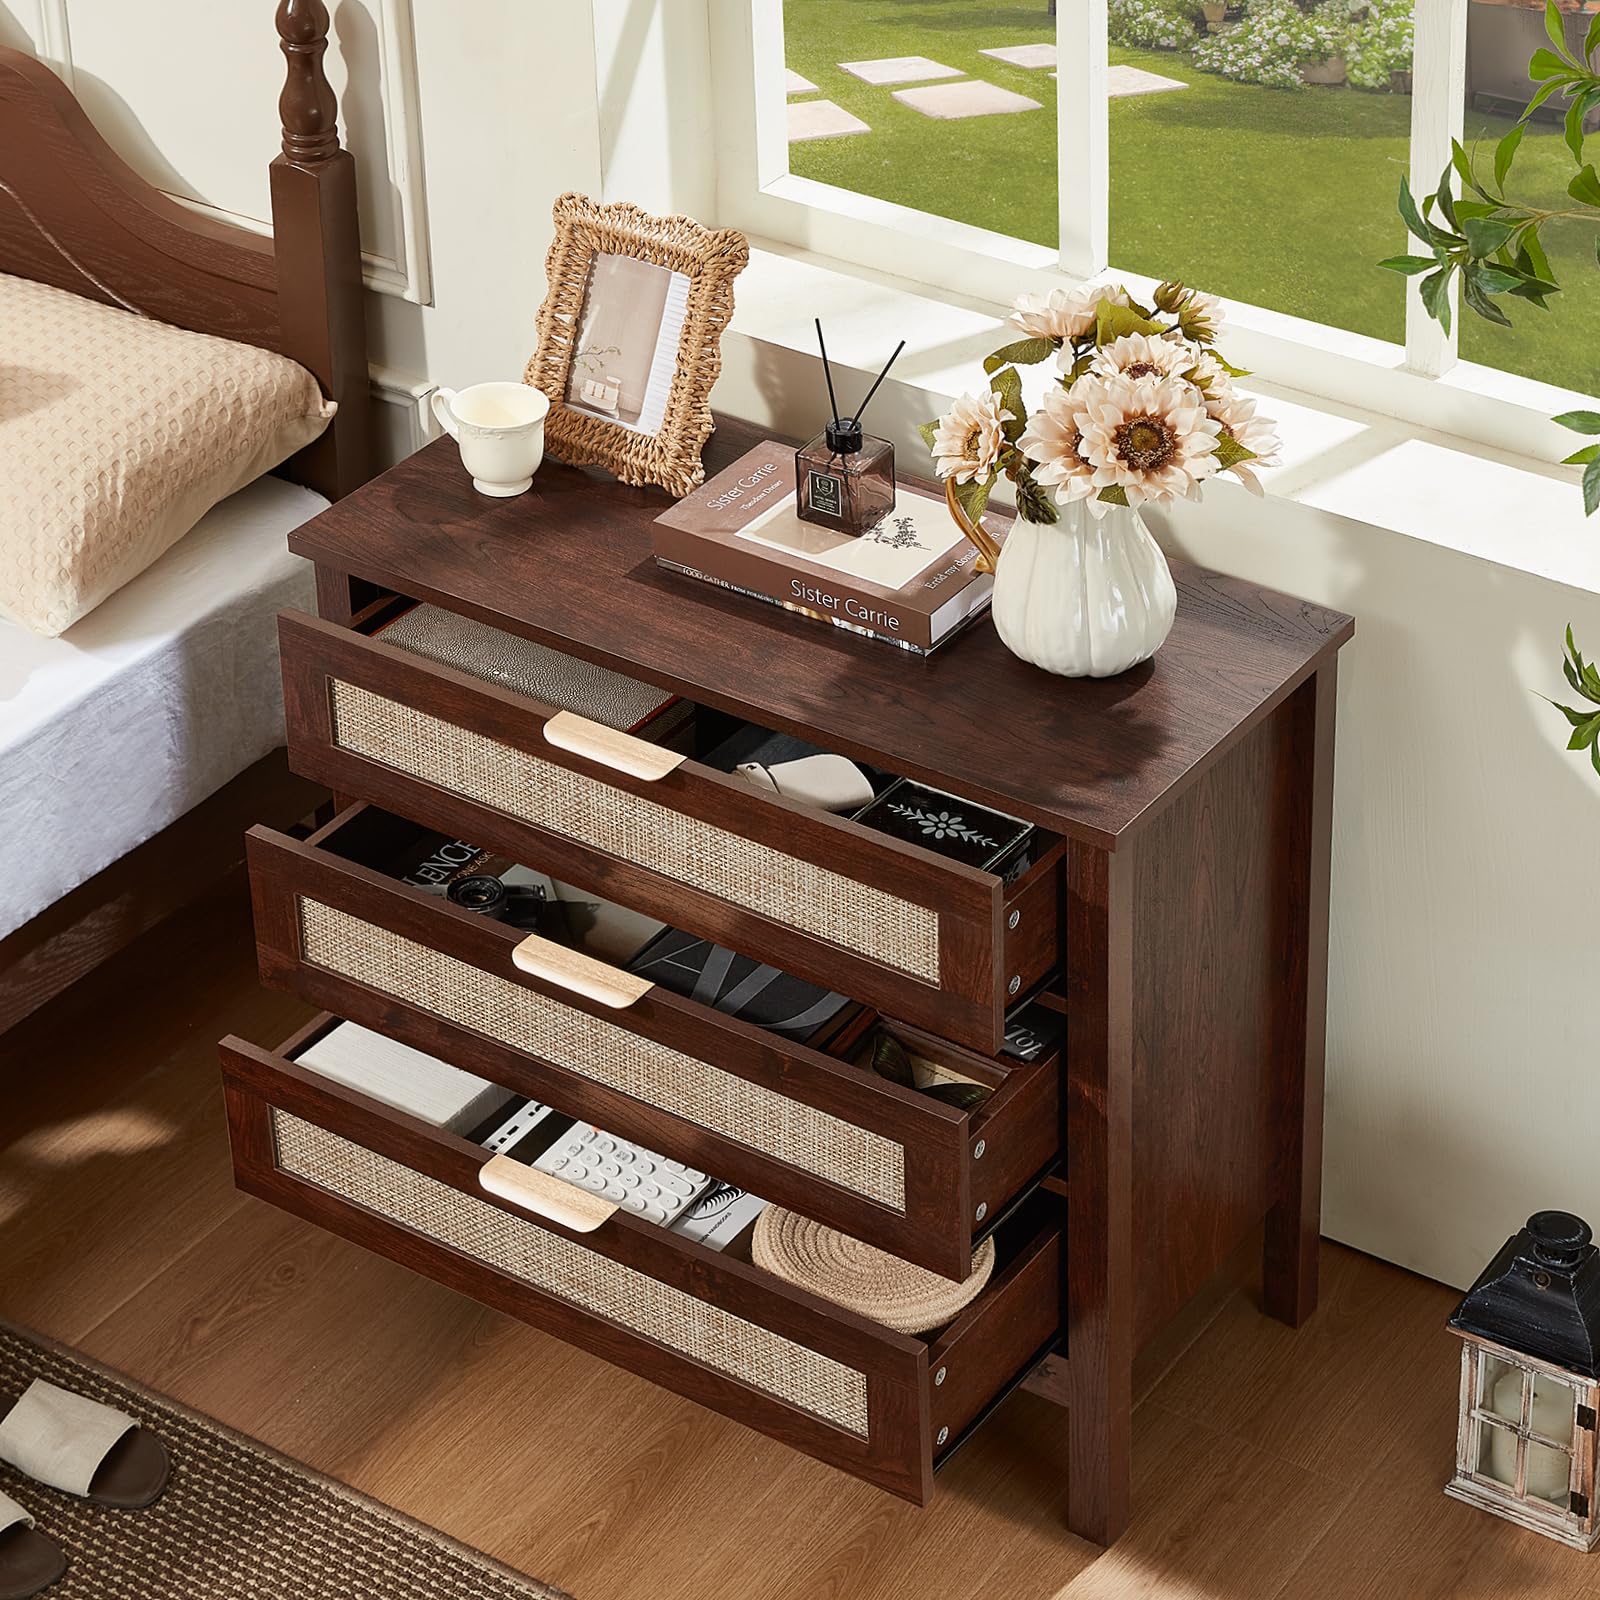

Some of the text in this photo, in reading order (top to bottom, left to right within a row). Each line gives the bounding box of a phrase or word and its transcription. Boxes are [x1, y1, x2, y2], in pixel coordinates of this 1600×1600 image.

[706, 463, 778, 511] Sister Carrie
[703, 574, 730, 589] GATHER
[944, 564, 960, 576] my
[790, 579, 900, 631] Sister Carrie
